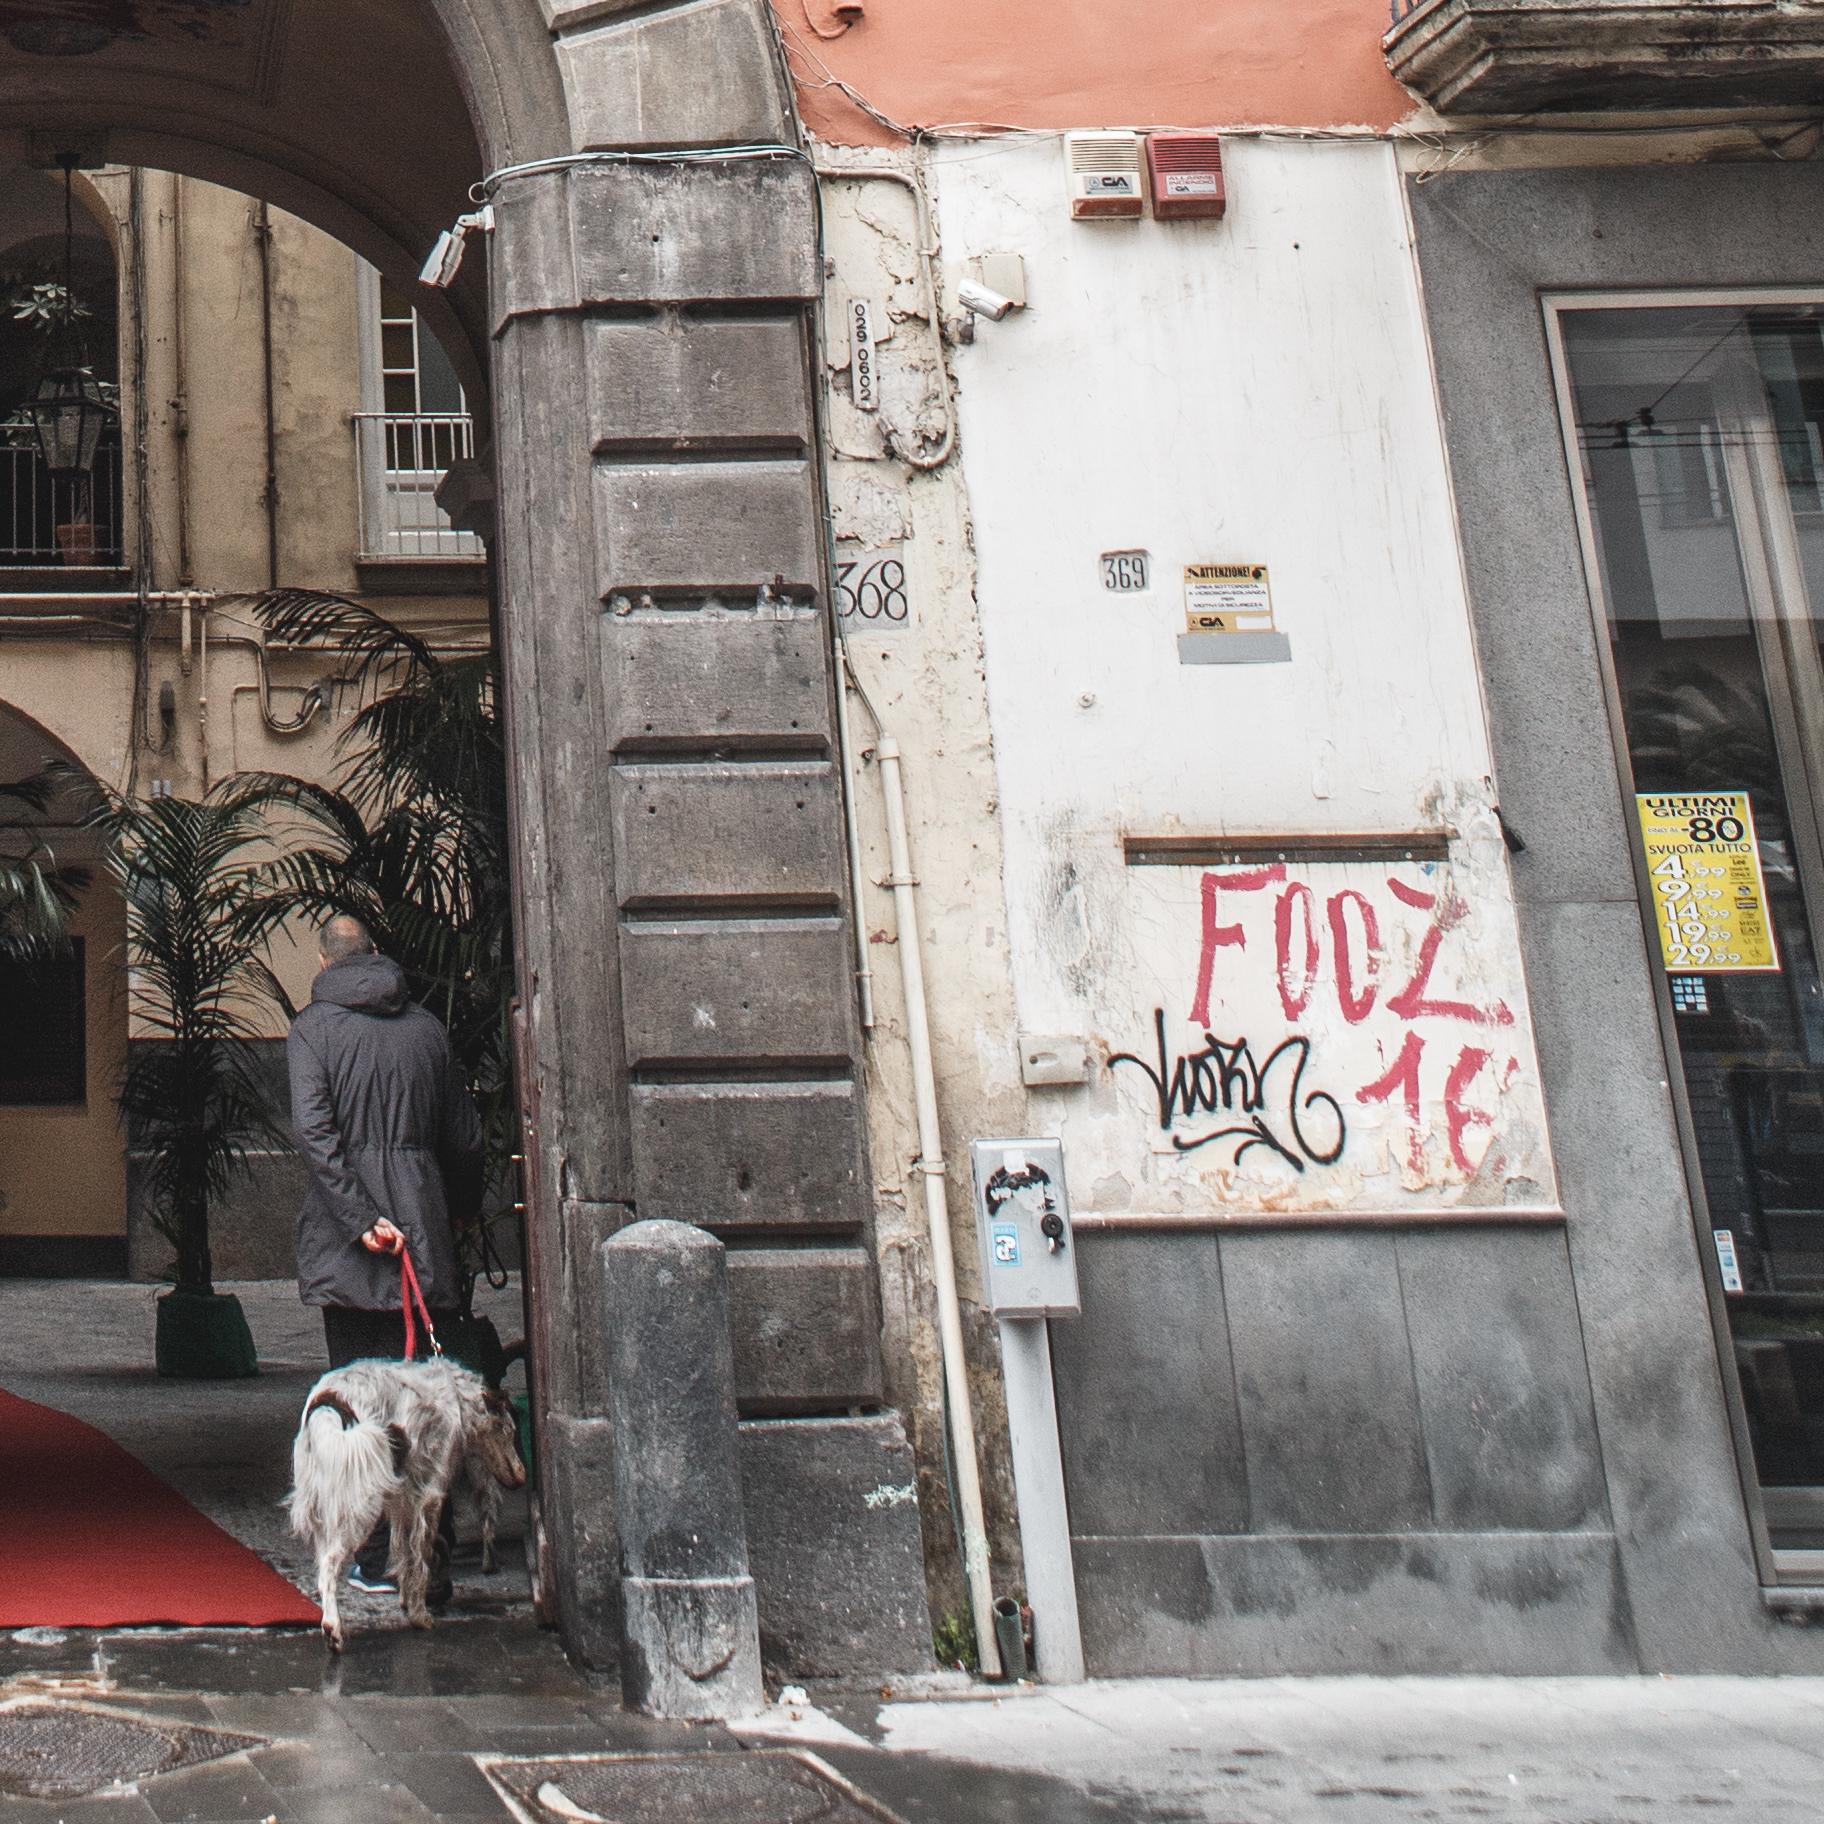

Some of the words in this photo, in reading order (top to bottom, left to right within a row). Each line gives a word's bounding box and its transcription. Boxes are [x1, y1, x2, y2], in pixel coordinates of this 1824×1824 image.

[857, 348, 871, 401] 0602
[1103, 557, 1145, 589] 369
[1199, 566, 1250, 579] ATTENZIONE!
[832, 559, 908, 621] 368
[1646, 797, 1736, 808] ULTIMI
[1653, 807, 1734, 817] GIORNI
[1648, 844, 1704, 855] SVUOTA
[1707, 843, 1752, 853] TUTTO
